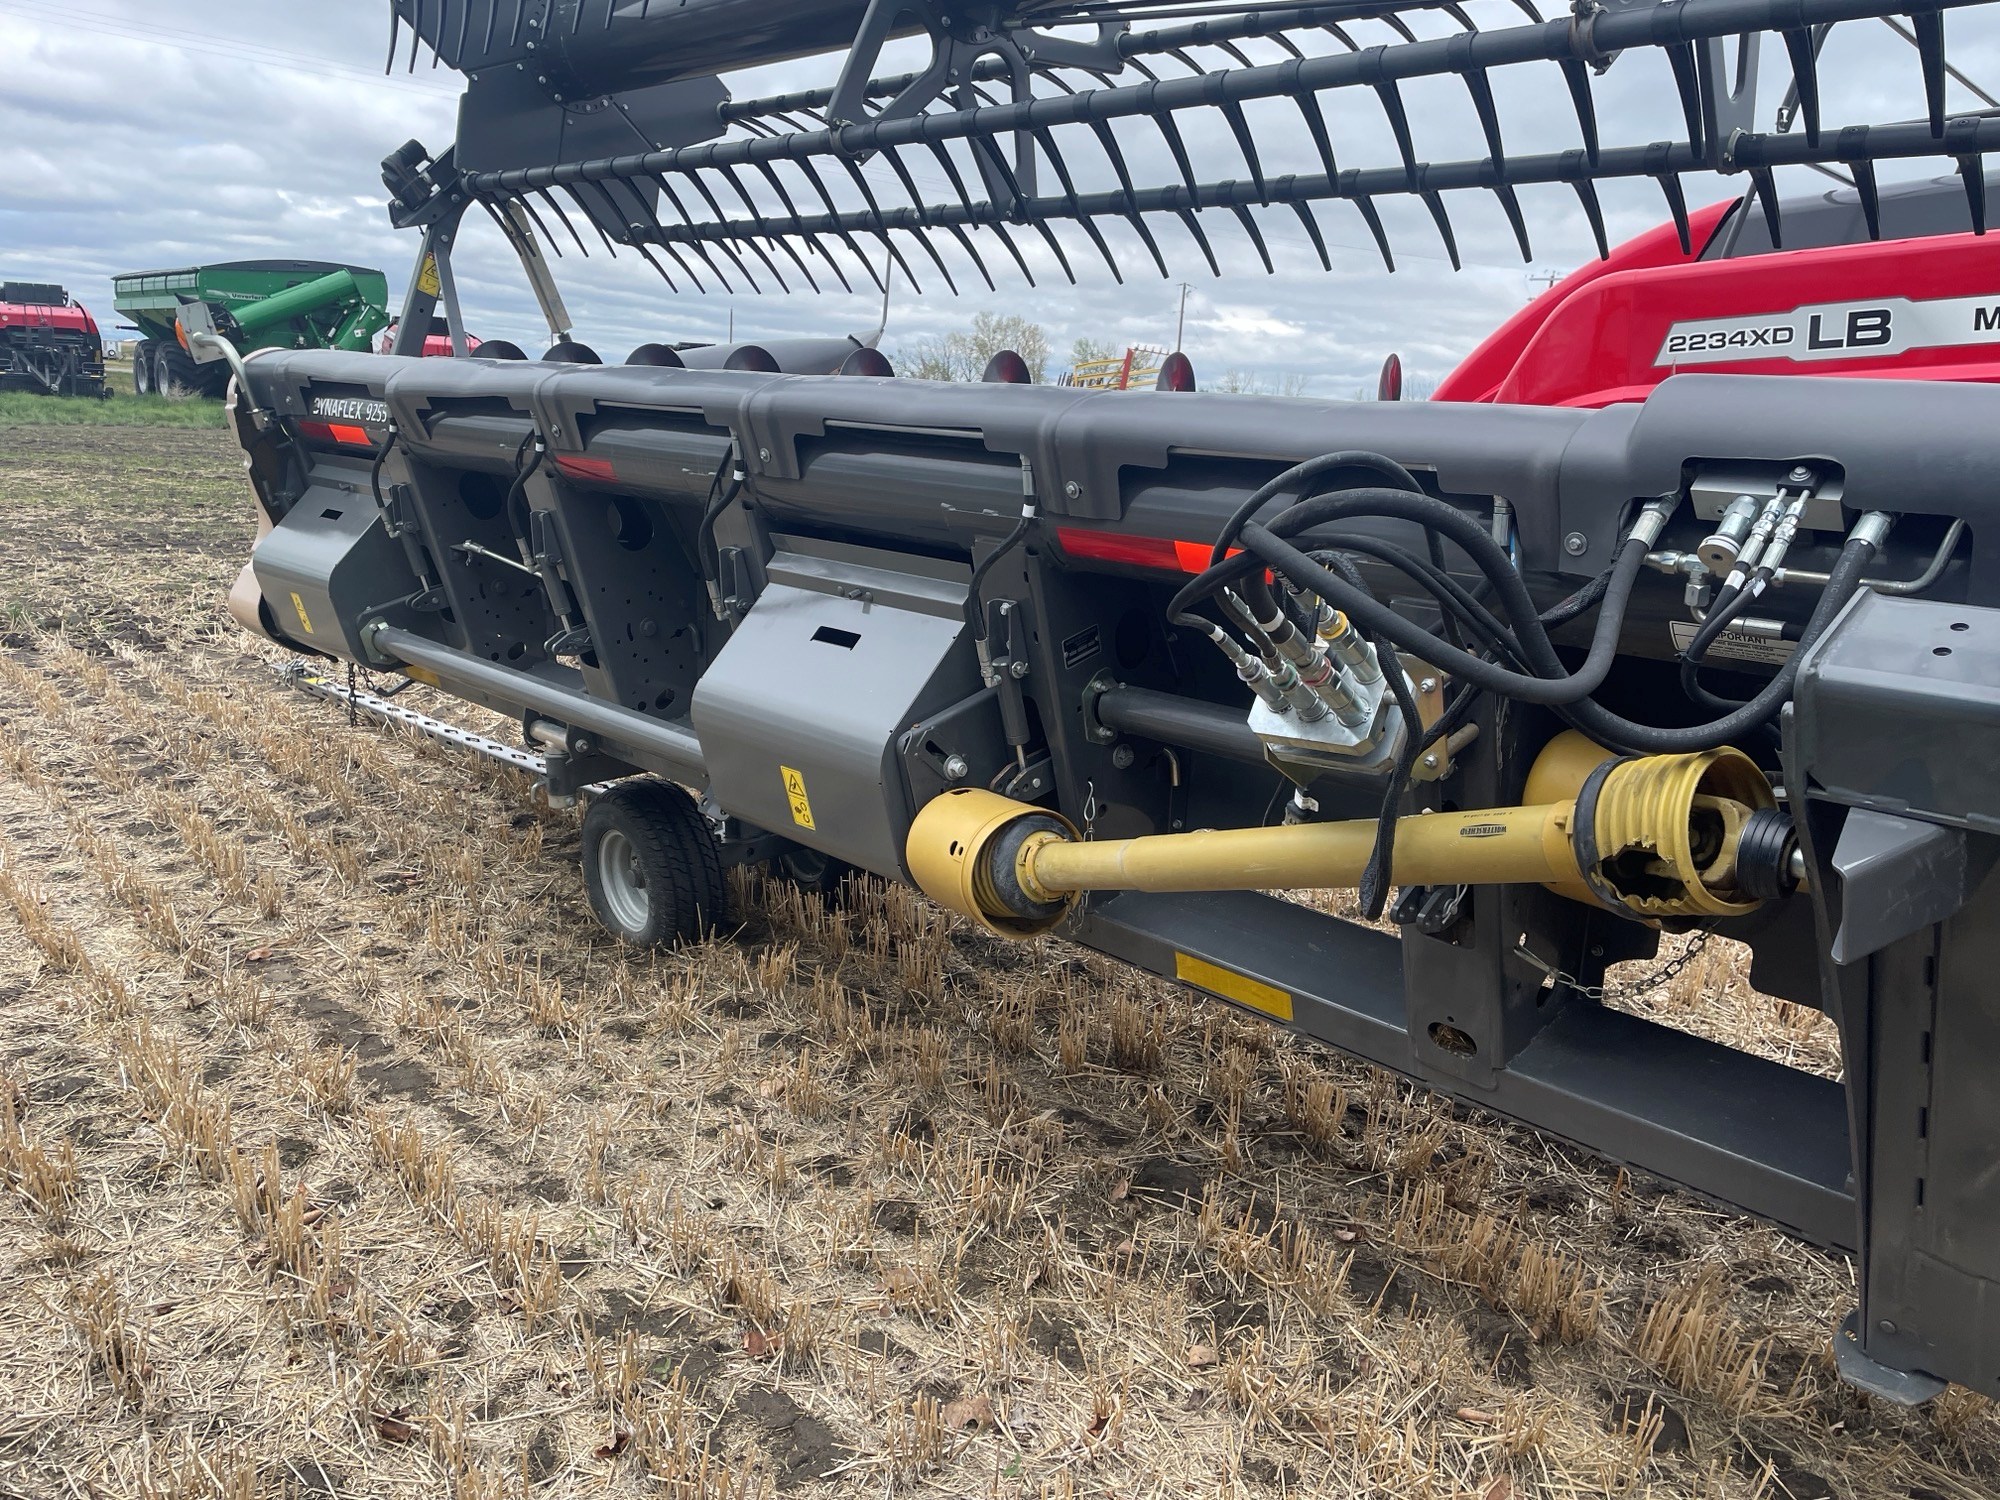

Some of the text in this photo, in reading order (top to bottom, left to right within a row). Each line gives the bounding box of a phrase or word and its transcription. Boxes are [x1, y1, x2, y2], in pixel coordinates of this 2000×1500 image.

[1668, 326, 1795, 353] 2234XD
[1807, 309, 1892, 351] LB
[1717, 632, 1767, 645] PORTANT
